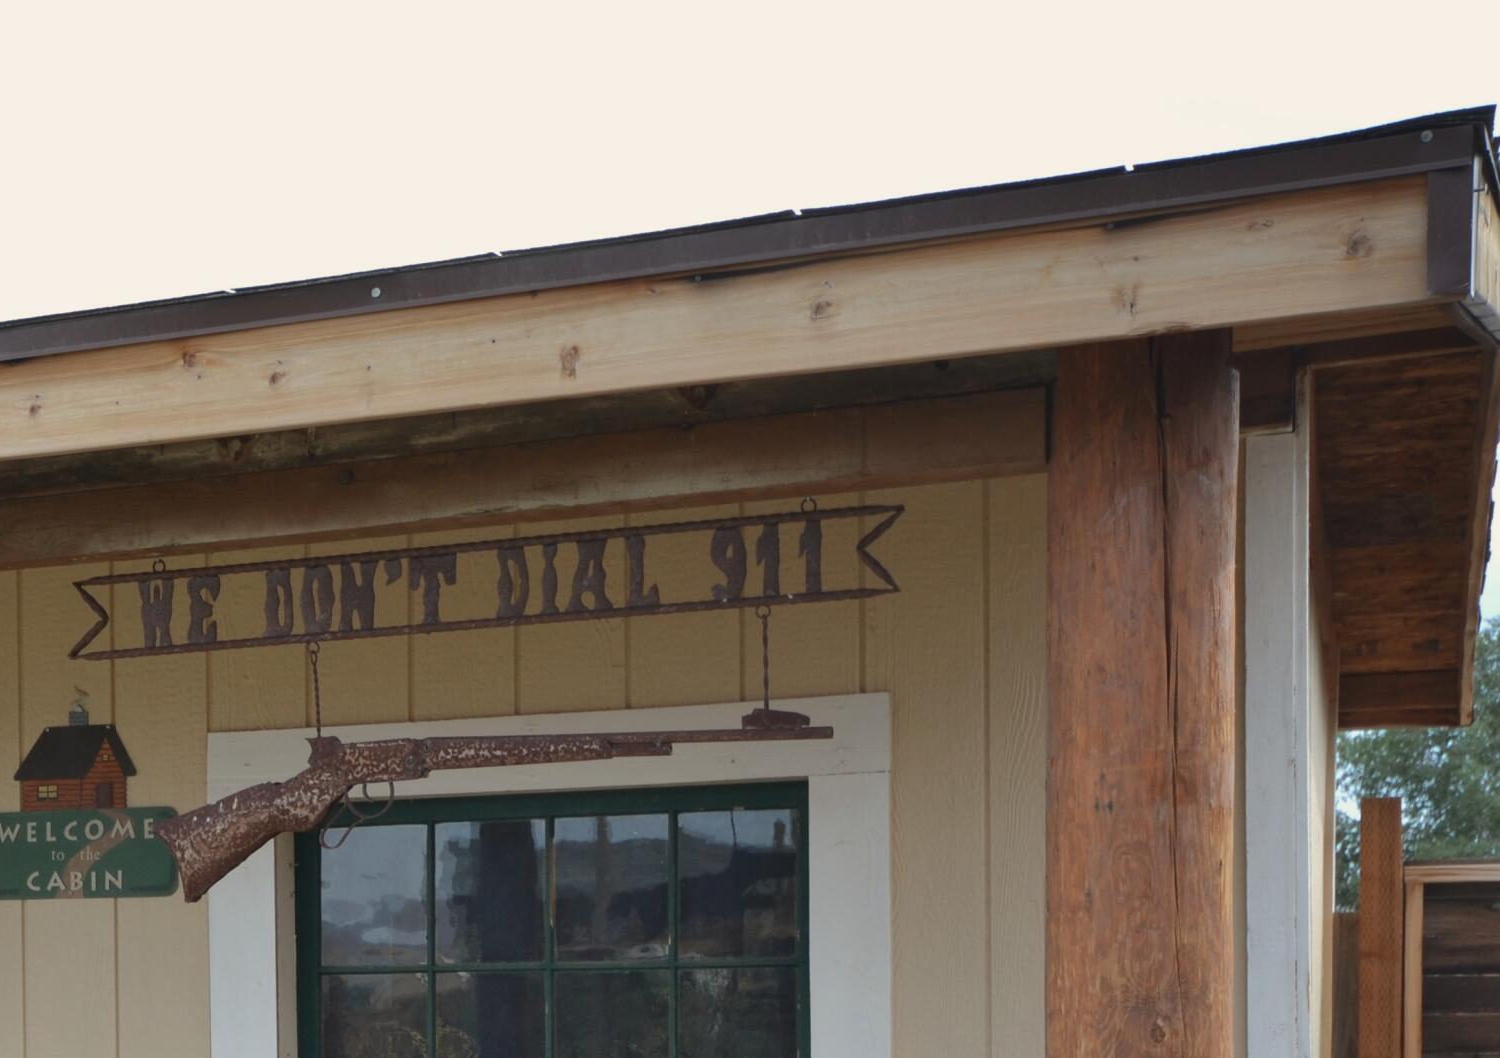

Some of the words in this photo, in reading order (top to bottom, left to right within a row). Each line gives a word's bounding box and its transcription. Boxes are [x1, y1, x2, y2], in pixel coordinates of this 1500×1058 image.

[138, 574, 221, 649] WE
[263, 553, 457, 640] DON'T
[496, 535, 660, 622] DIAL
[710, 518, 824, 604] 911
[51, 849, 65, 862] to
[80, 846, 101, 862] the
[26, 869, 124, 892] CABIN
